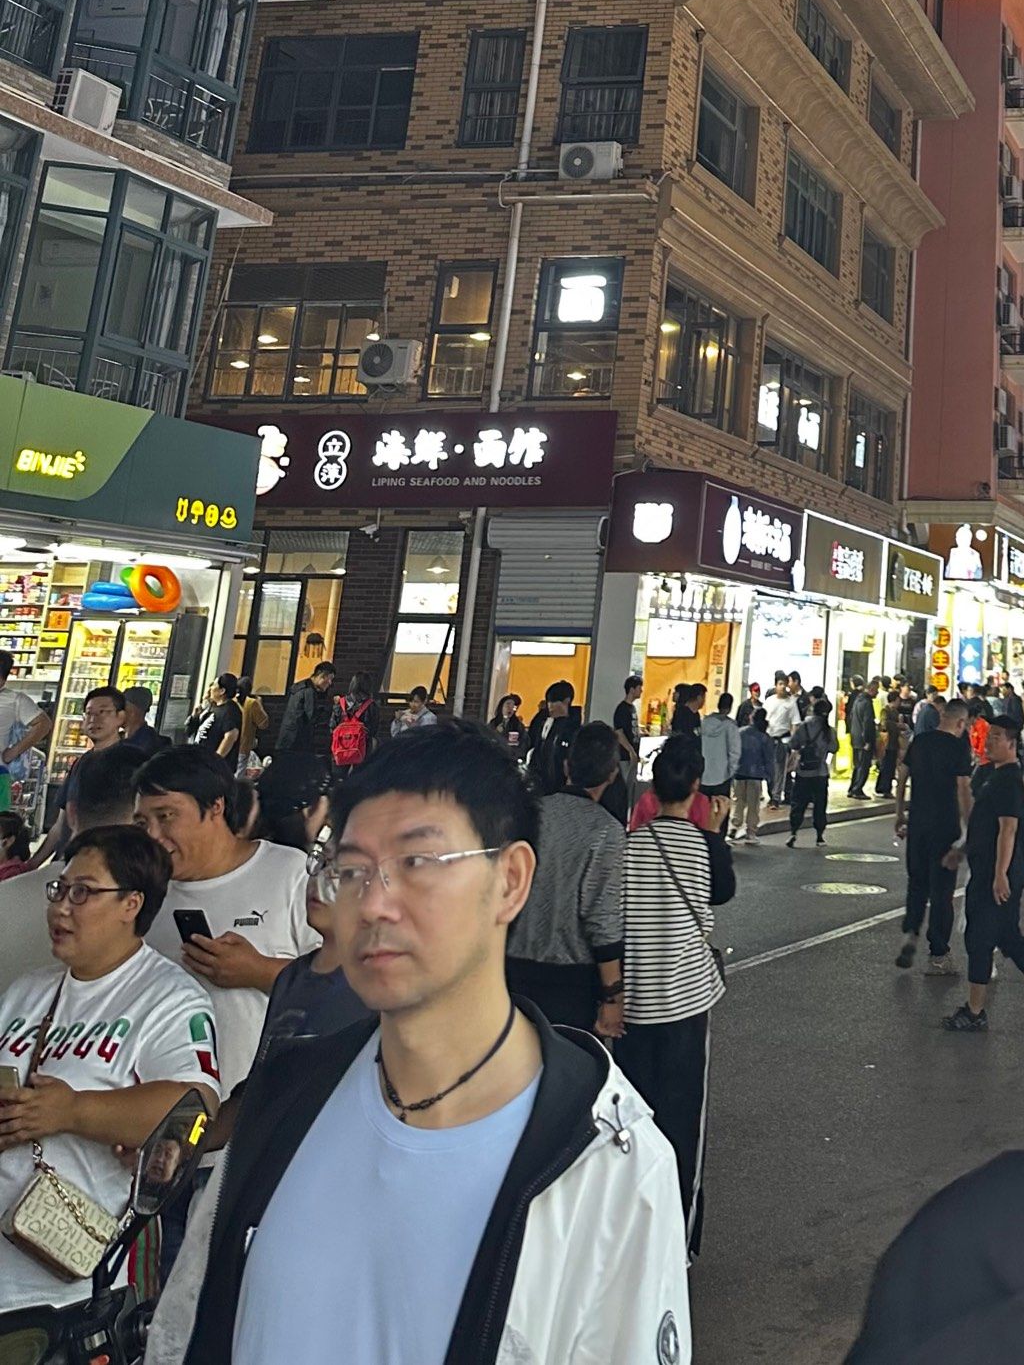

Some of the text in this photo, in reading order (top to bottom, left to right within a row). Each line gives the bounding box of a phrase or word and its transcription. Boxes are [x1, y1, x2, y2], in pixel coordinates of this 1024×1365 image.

[16, 449, 77, 479] BINJIE
[372, 476, 542, 487] LIPING SEAFOOD AND NOODLES
